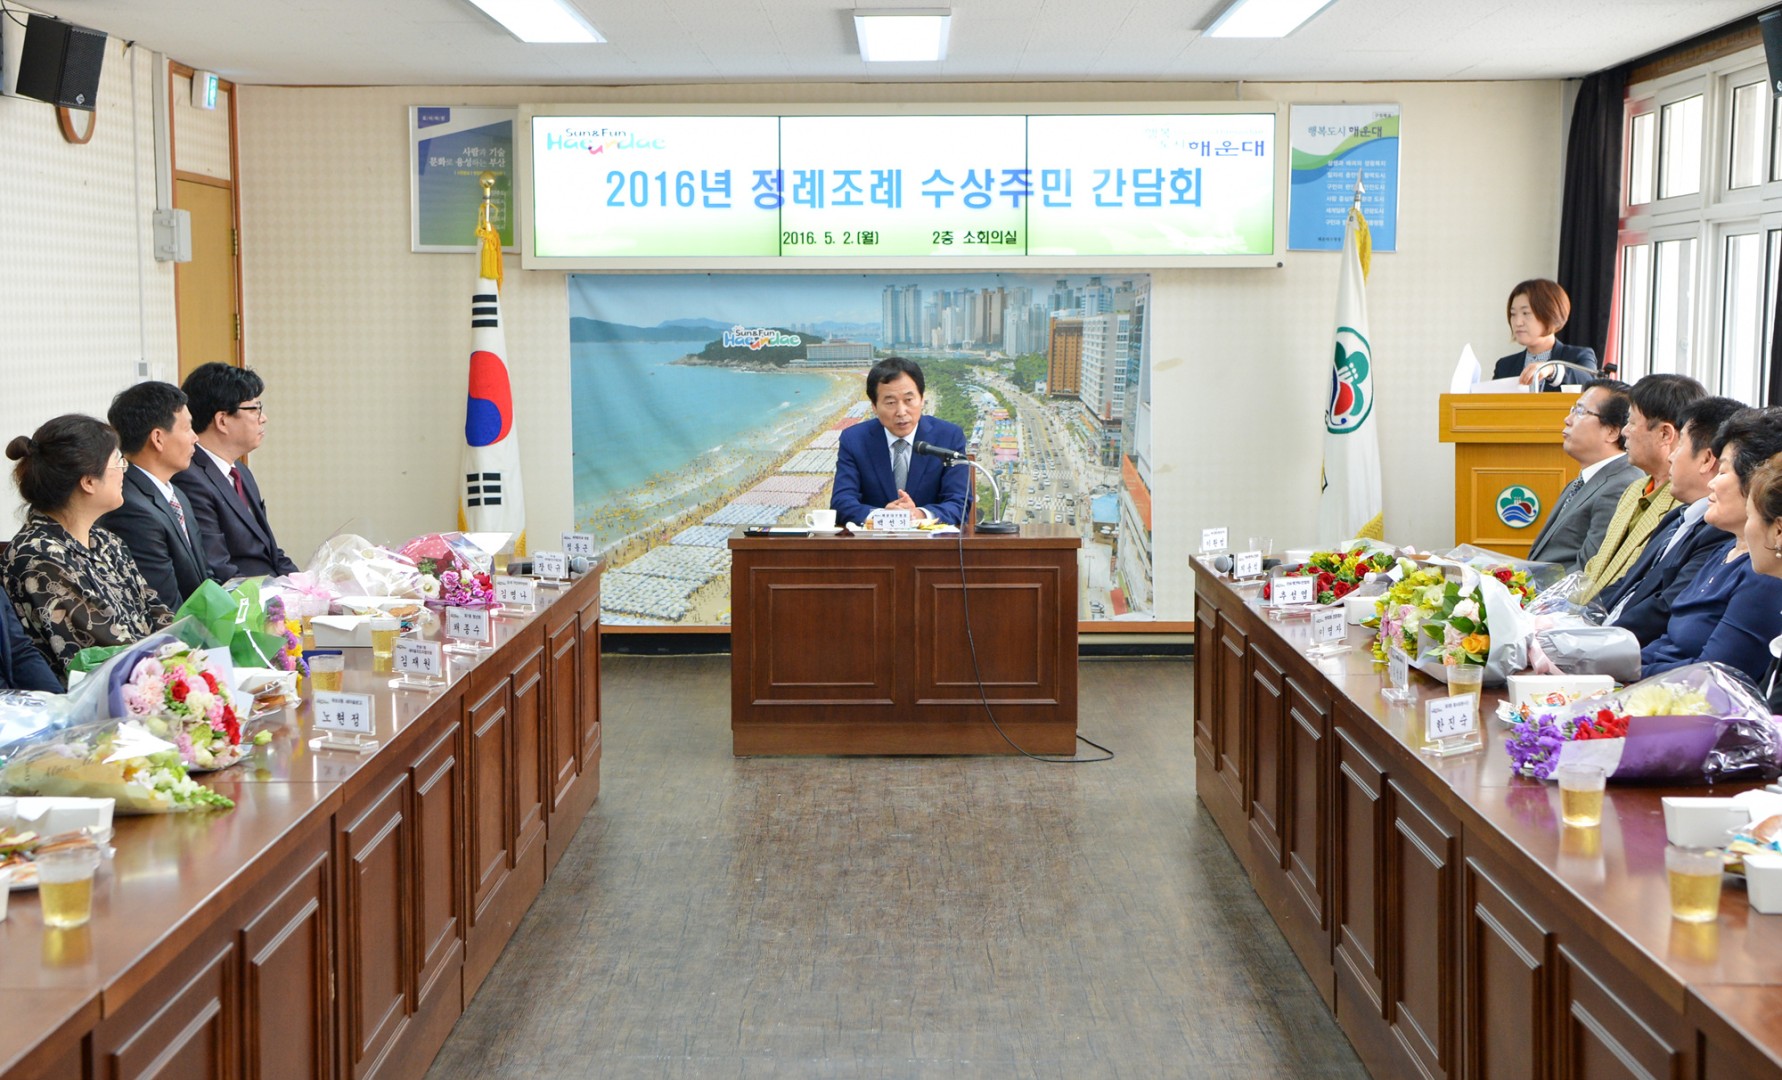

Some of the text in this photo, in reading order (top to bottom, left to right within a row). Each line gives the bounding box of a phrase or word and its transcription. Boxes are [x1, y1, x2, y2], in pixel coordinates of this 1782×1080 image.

[565, 128, 627, 137] Sun&Fun
[1308, 126, 1382, 138] 행복도시 해운대
[489, 147, 506, 157] 기술
[1188, 140, 1265, 157] 해운대
[489, 157, 506, 167] 부산
[606, 168, 1202, 209] 2016년 정례조례 수상주민 간담회
[783, 231, 817, 245] 2016.
[824, 231, 836, 245] 5.
[932, 230, 1017, 245] 2층 소회의실
[735, 329, 775, 337] Sun&Fun
[723, 331, 801, 350] Haeundae
[400, 654, 431, 671] 김재원
[321, 711, 360, 728] 노현정
